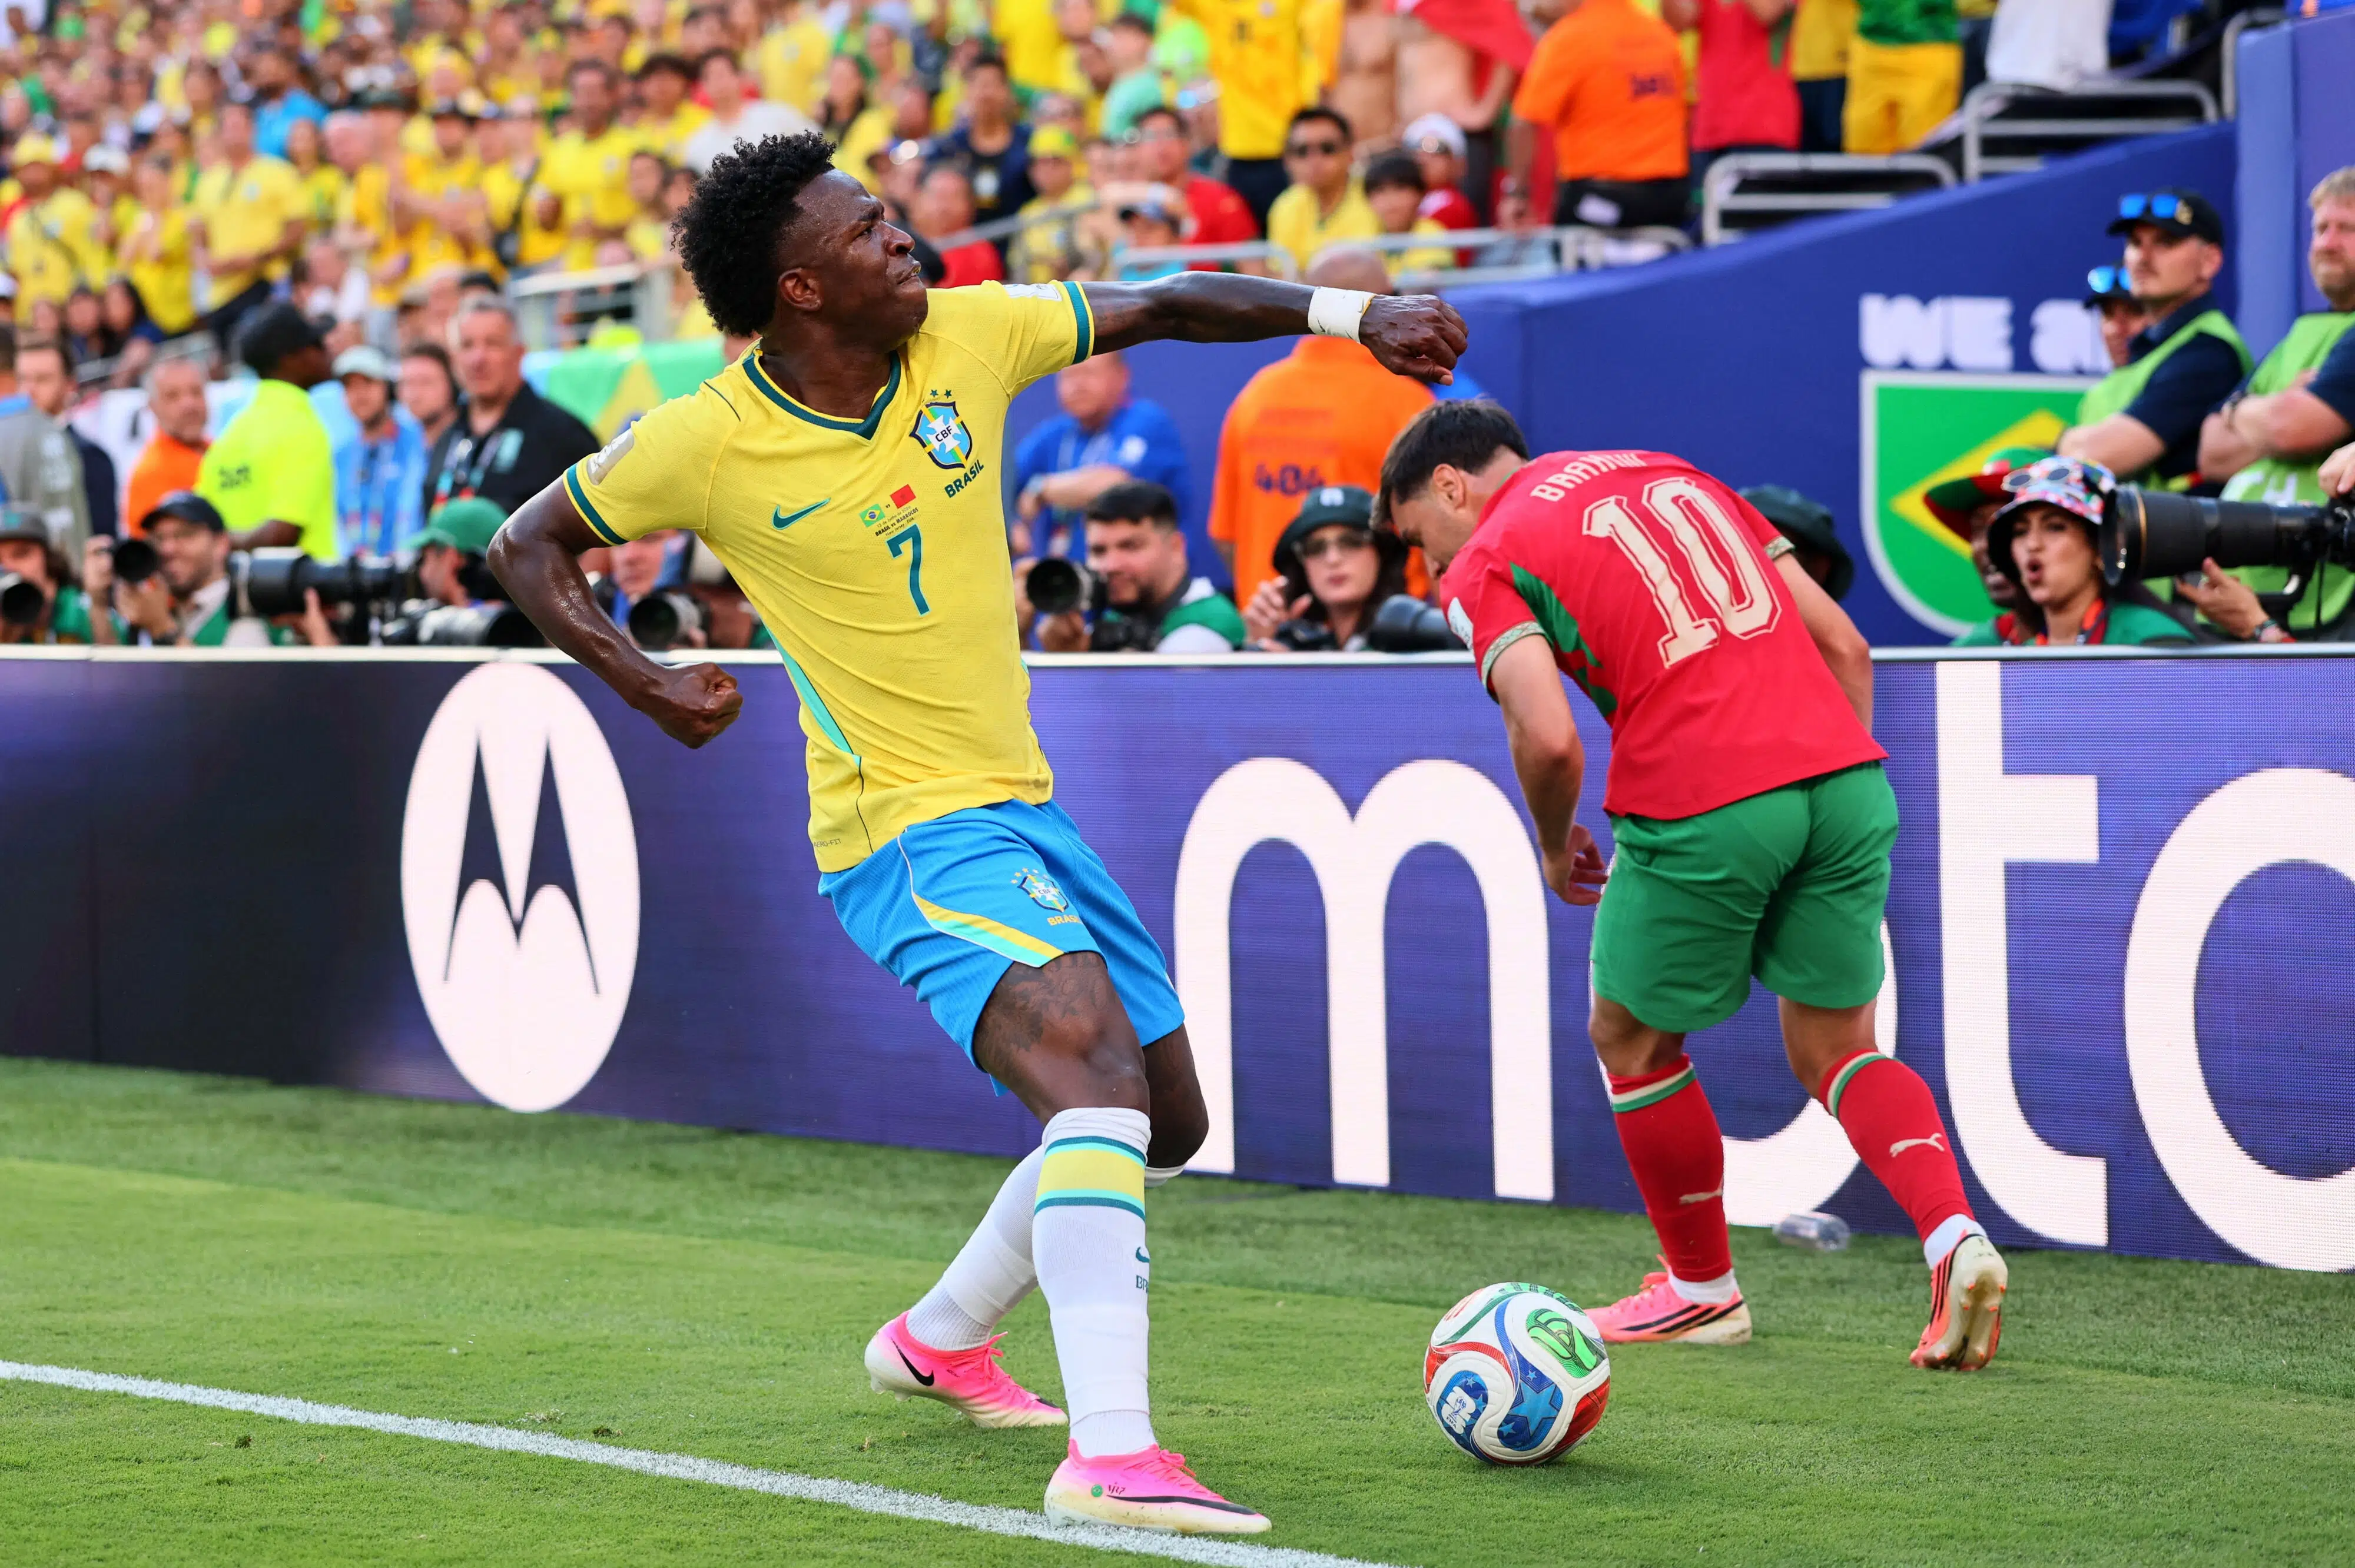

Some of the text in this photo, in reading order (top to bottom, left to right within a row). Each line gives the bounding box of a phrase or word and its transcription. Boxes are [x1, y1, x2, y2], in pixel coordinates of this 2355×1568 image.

[936, 426, 953, 442] CBF
[944, 459, 984, 499] BRASIL
[875, 526, 891, 536] BRASIL
[896, 507, 918, 523] MARROCOS
[885, 523, 931, 617] 7
[1581, 476, 1783, 669] 10
[814, 838, 842, 848] AERO-FIT
